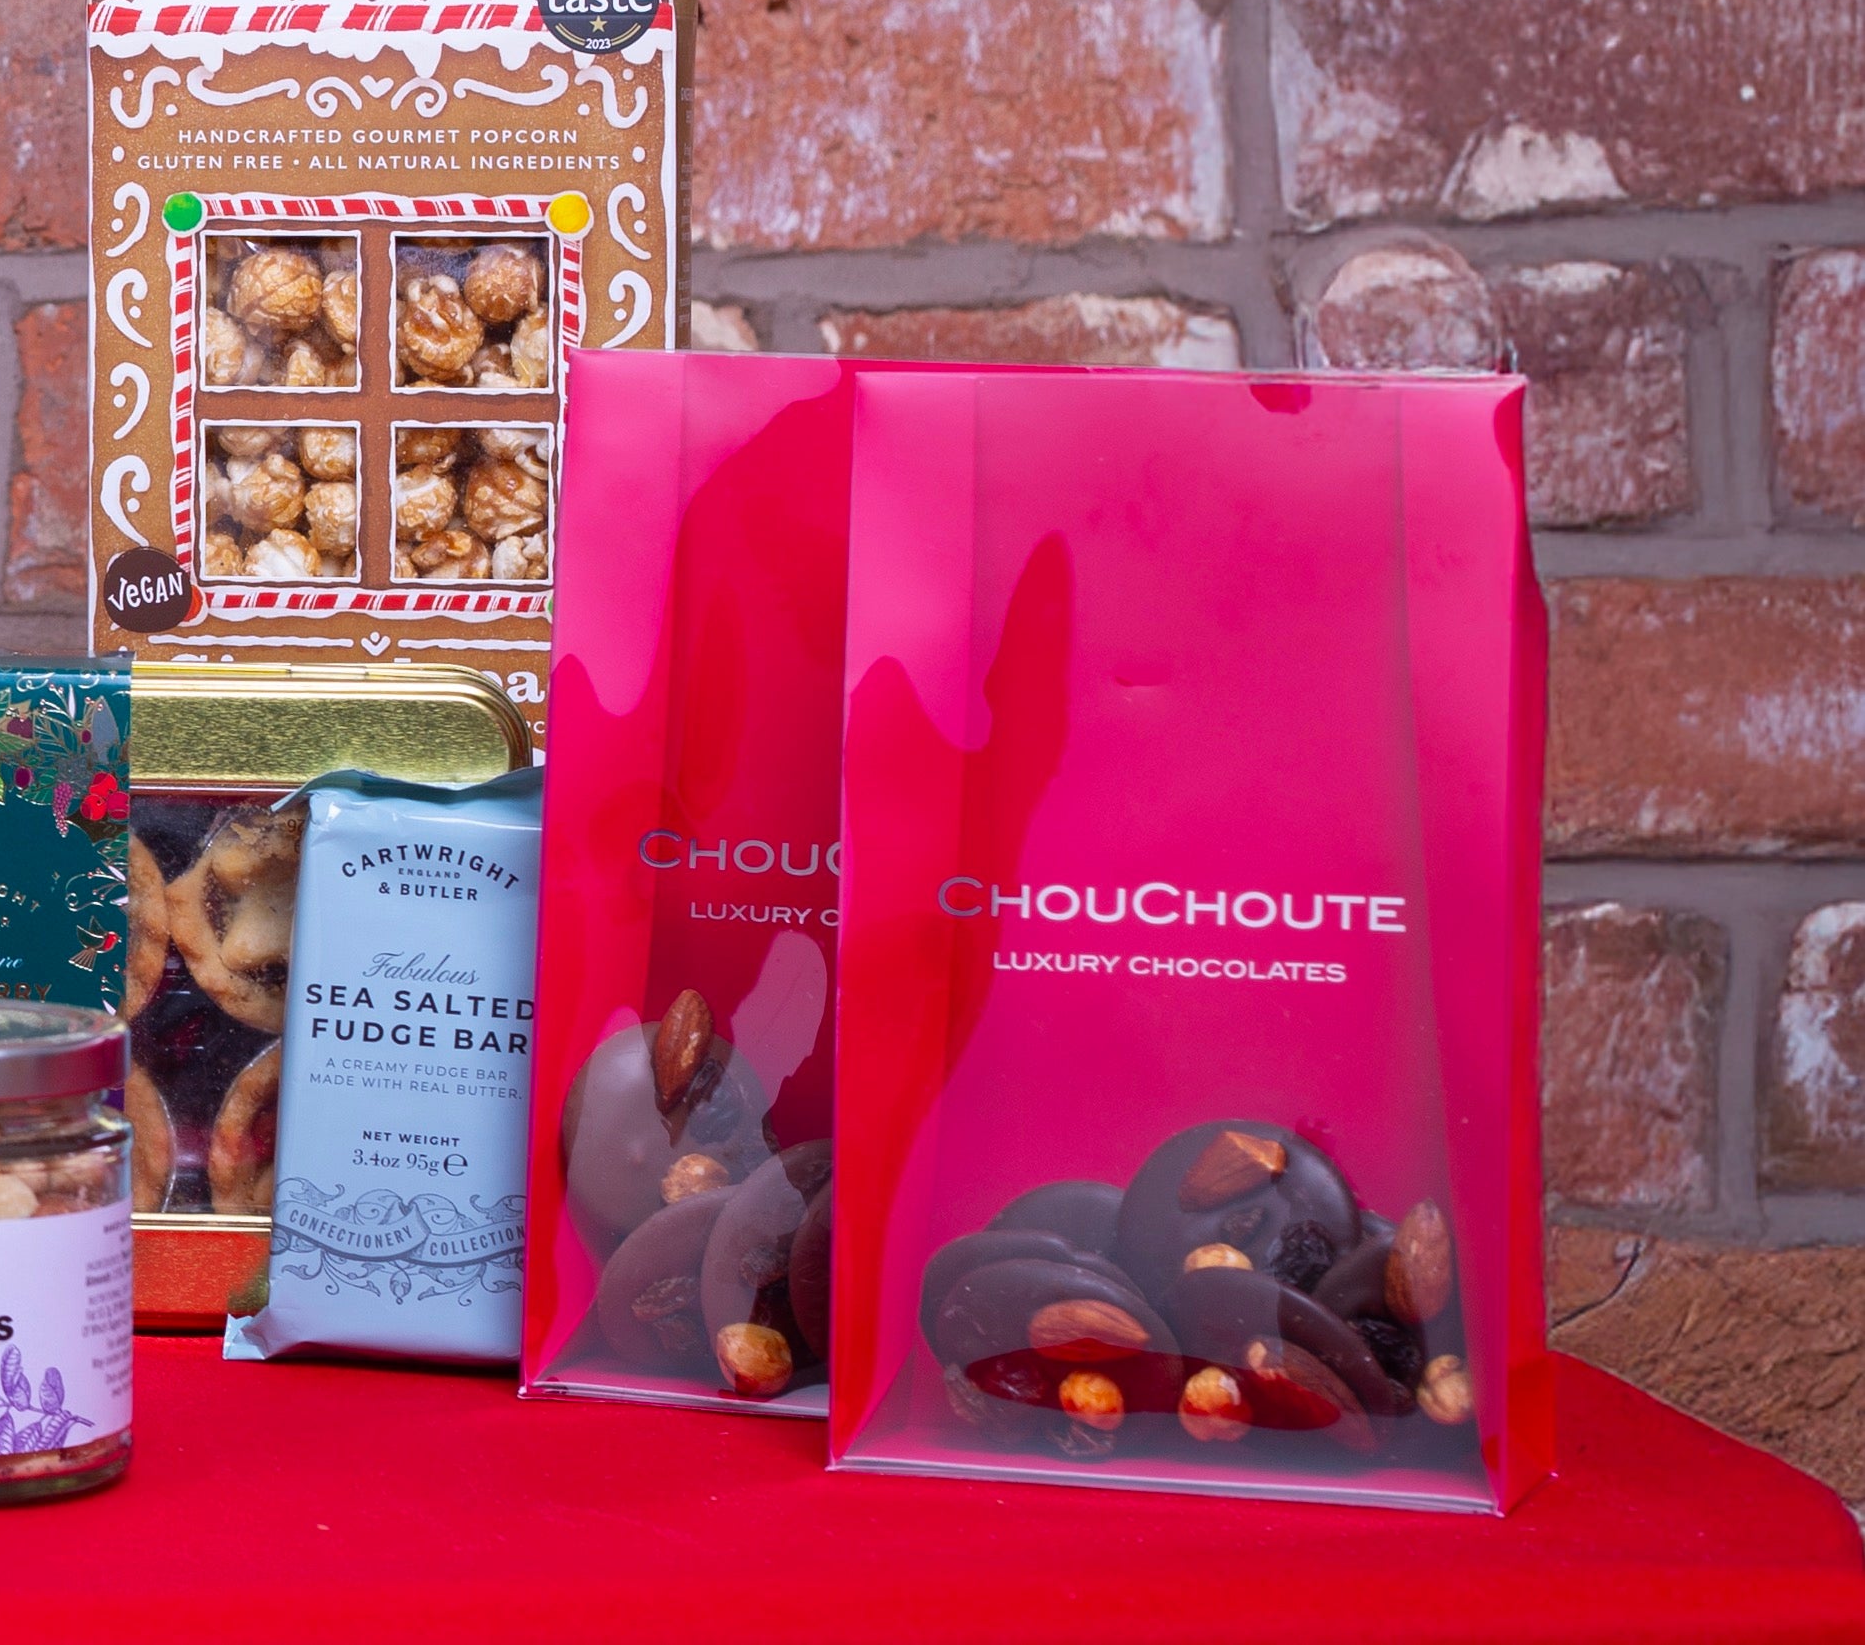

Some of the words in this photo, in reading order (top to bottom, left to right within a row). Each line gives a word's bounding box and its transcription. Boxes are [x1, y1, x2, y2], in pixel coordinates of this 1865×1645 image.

[584, 37, 612, 50] 2023
[178, 129, 342, 145] HANDCRAFTED
[352, 129, 460, 145] GOURMET
[470, 129, 579, 145] POPCORN
[137, 155, 224, 171] GLUTEN
[233, 155, 283, 171] FREE
[309, 155, 348, 171] ALL
[358, 155, 462, 171] NATURAL
[471, 155, 621, 171] INGREDIENTS
[341, 843, 520, 891] CARTWRIGHT
[398, 867, 462, 880] ENGLAND
[378, 881, 391, 895] &
[400, 883, 479, 902] BUTLER
[690, 900, 812, 925] LUXURY
[362, 951, 481, 987] Fabulous
[992, 950, 1122, 975] LUXURY
[1127, 954, 1348, 985] CHOCOLATES
[305, 982, 375, 1010] SEA
[394, 990, 535, 1022] SALTED
[311, 1017, 437, 1048] FUDGE
[454, 1028, 529, 1055] BAR
[325, 1056, 337, 1069] A
[342, 1058, 408, 1074] CREAMY
[414, 1063, 469, 1079] FUDGE
[476, 1068, 508, 1082] BAR
[309, 1072, 355, 1087] MADE
[361, 1077, 403, 1091] WITH
[409, 1080, 450, 1095] REAL
[456, 1084, 523, 1101] BUTTER.
[362, 1130, 392, 1143] NET
[398, 1133, 461, 1148] WEIGHT
[289, 1208, 414, 1250] CONFECTIONERY
[429, 1225, 527, 1257] COLLECTION
